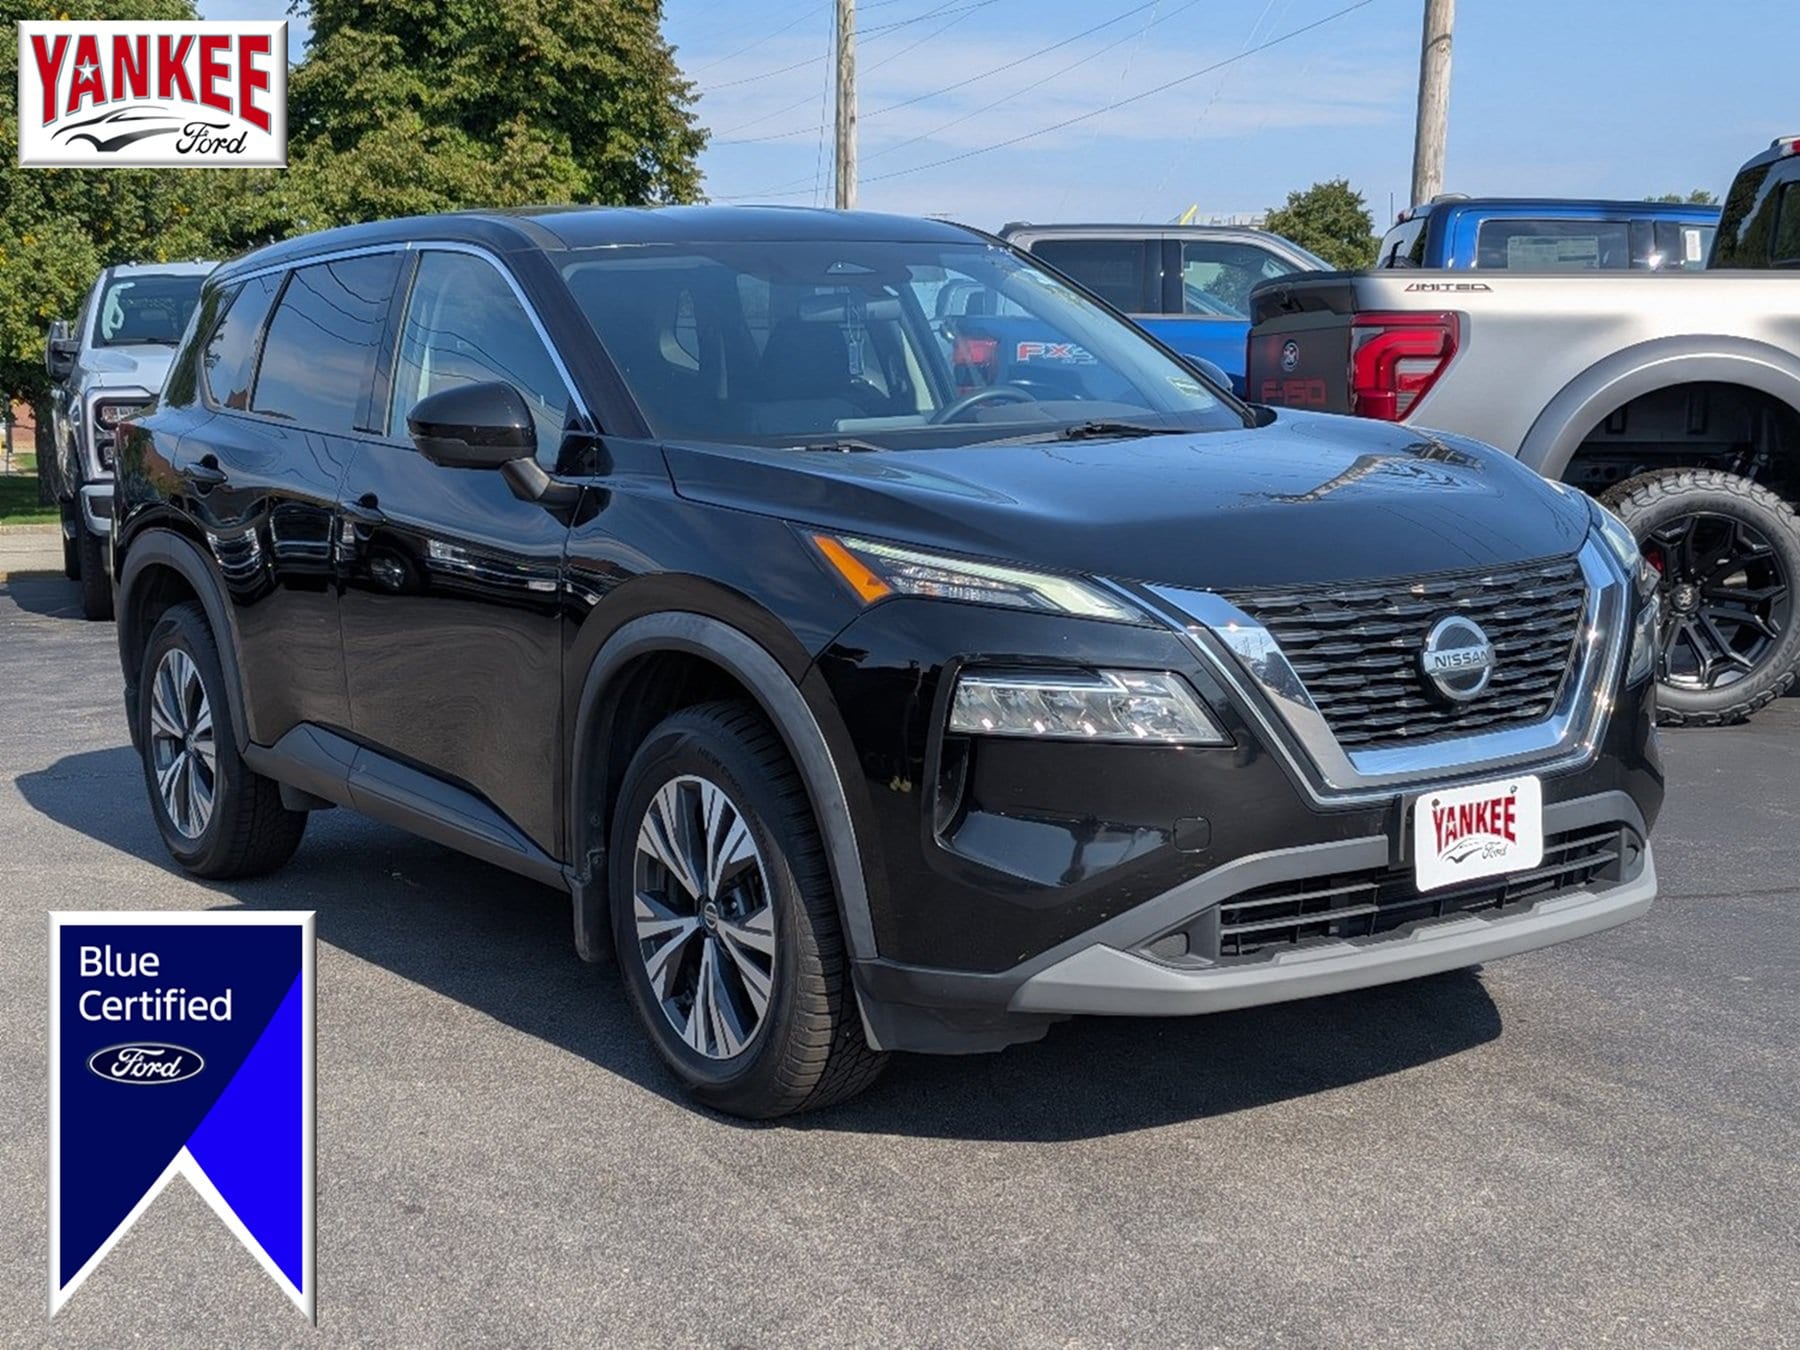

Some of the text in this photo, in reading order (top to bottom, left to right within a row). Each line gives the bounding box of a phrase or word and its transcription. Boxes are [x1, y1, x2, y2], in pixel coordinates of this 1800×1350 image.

[1404, 283, 1494, 293] LIMITED
[1434, 650, 1490, 668] NISSAN
[1432, 796, 1516, 856] YANKEE
